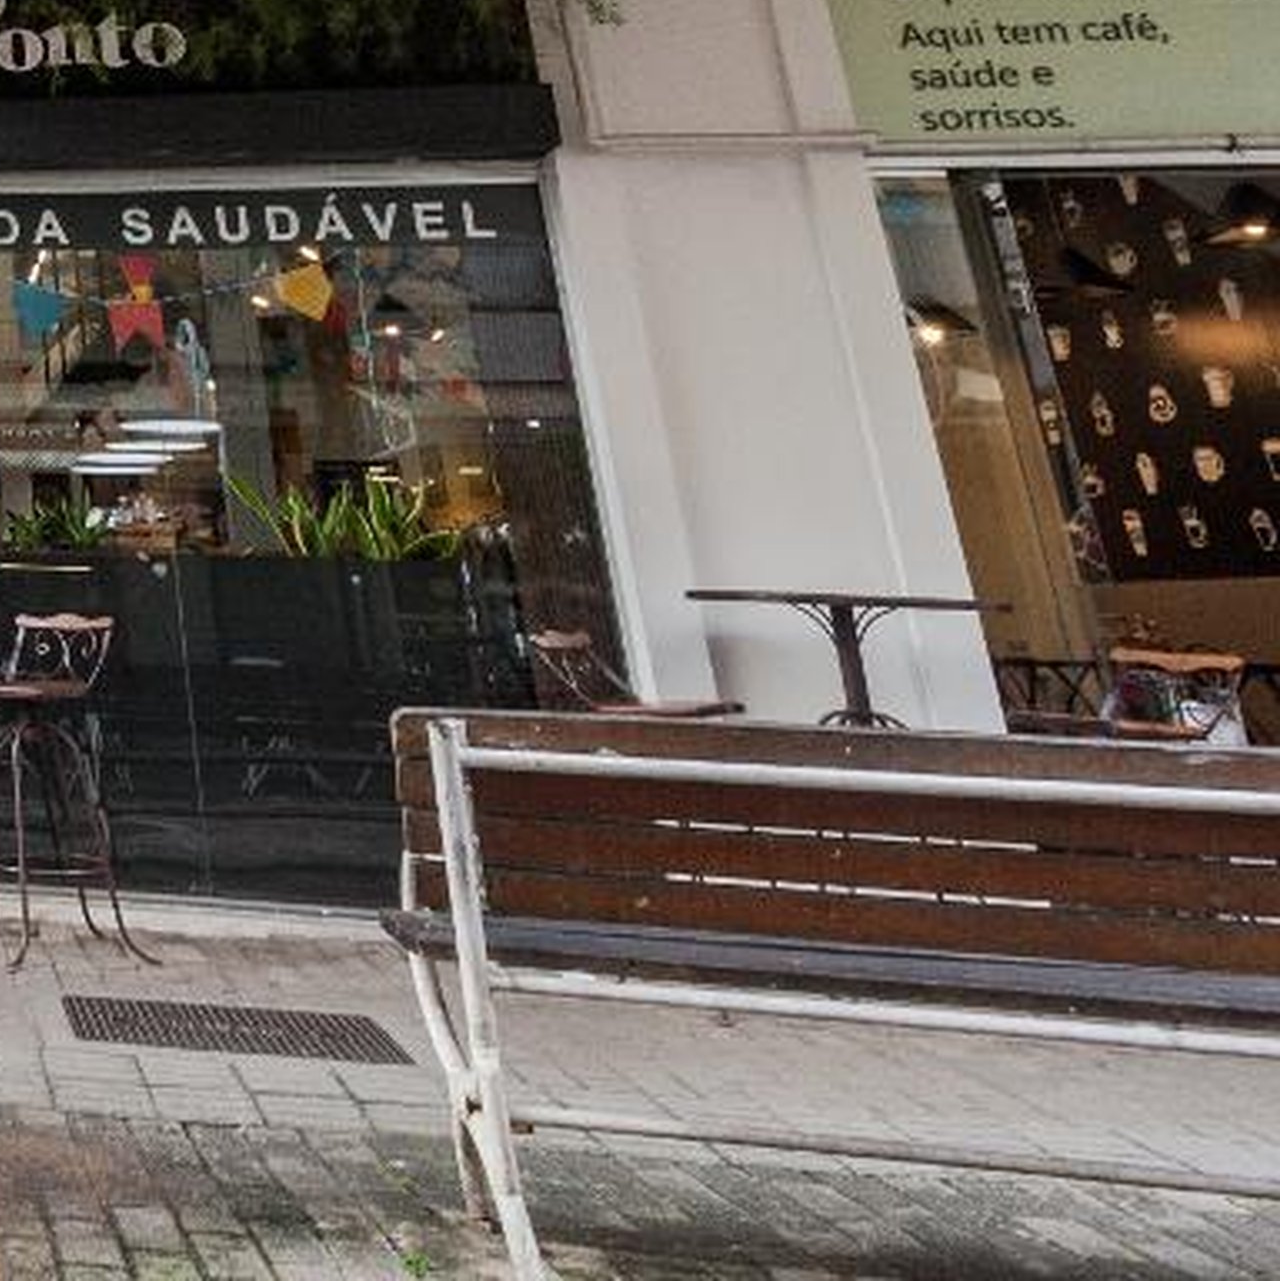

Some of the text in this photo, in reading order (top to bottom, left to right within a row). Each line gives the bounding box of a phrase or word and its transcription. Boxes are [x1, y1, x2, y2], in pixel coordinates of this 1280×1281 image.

[899, 11, 1171, 54] Aqui tem café,
[909, 60, 1056, 92] saúde e
[918, 102, 1076, 132] sorrisos.
[121, 192, 498, 245] SAUDÁVEL
